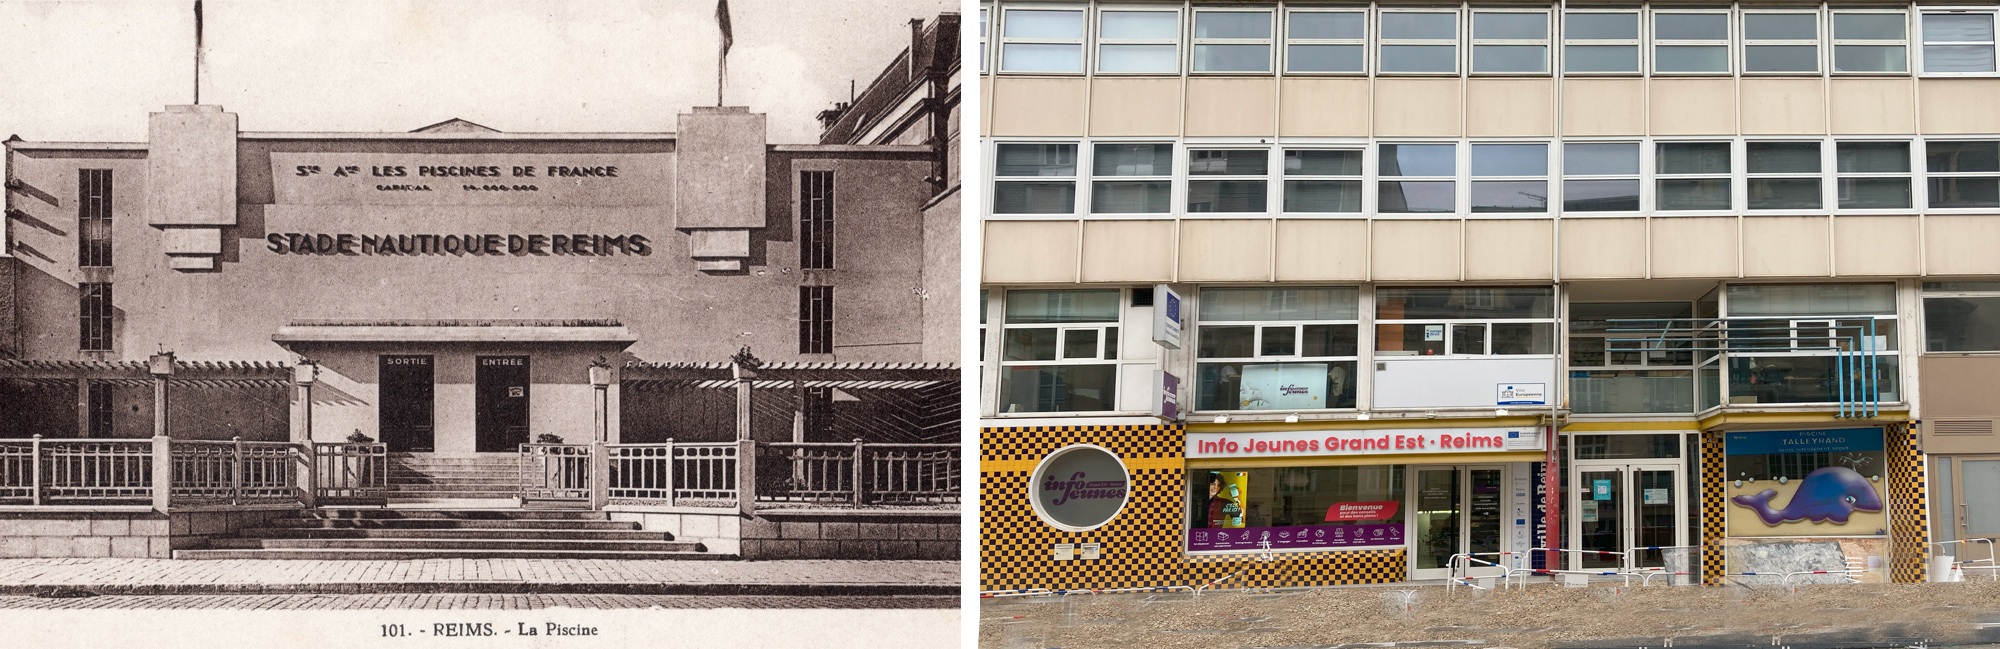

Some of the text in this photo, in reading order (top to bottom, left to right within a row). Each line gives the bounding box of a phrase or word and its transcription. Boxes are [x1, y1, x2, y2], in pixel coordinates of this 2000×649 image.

[372, 165, 407, 177] LES
[419, 165, 501, 177] PISCINES
[513, 165, 537, 177] DE
[547, 165, 618, 178] FRANCE
[267, 233, 652, 257] STADE NAUTIQUE DE REIMS
[1198, 437, 1239, 454] Info
[1243, 438, 1320, 453] Jeunes
[1324, 434, 1390, 451] Grand
[1395, 434, 1425, 449] Est
[1440, 432, 1504, 449] Reims
[1782, 436, 1846, 446] TALLEYRAND
[1339, 503, 1384, 511] Bienvenue
[1537, 461, 1547, 549] ville de Reim
